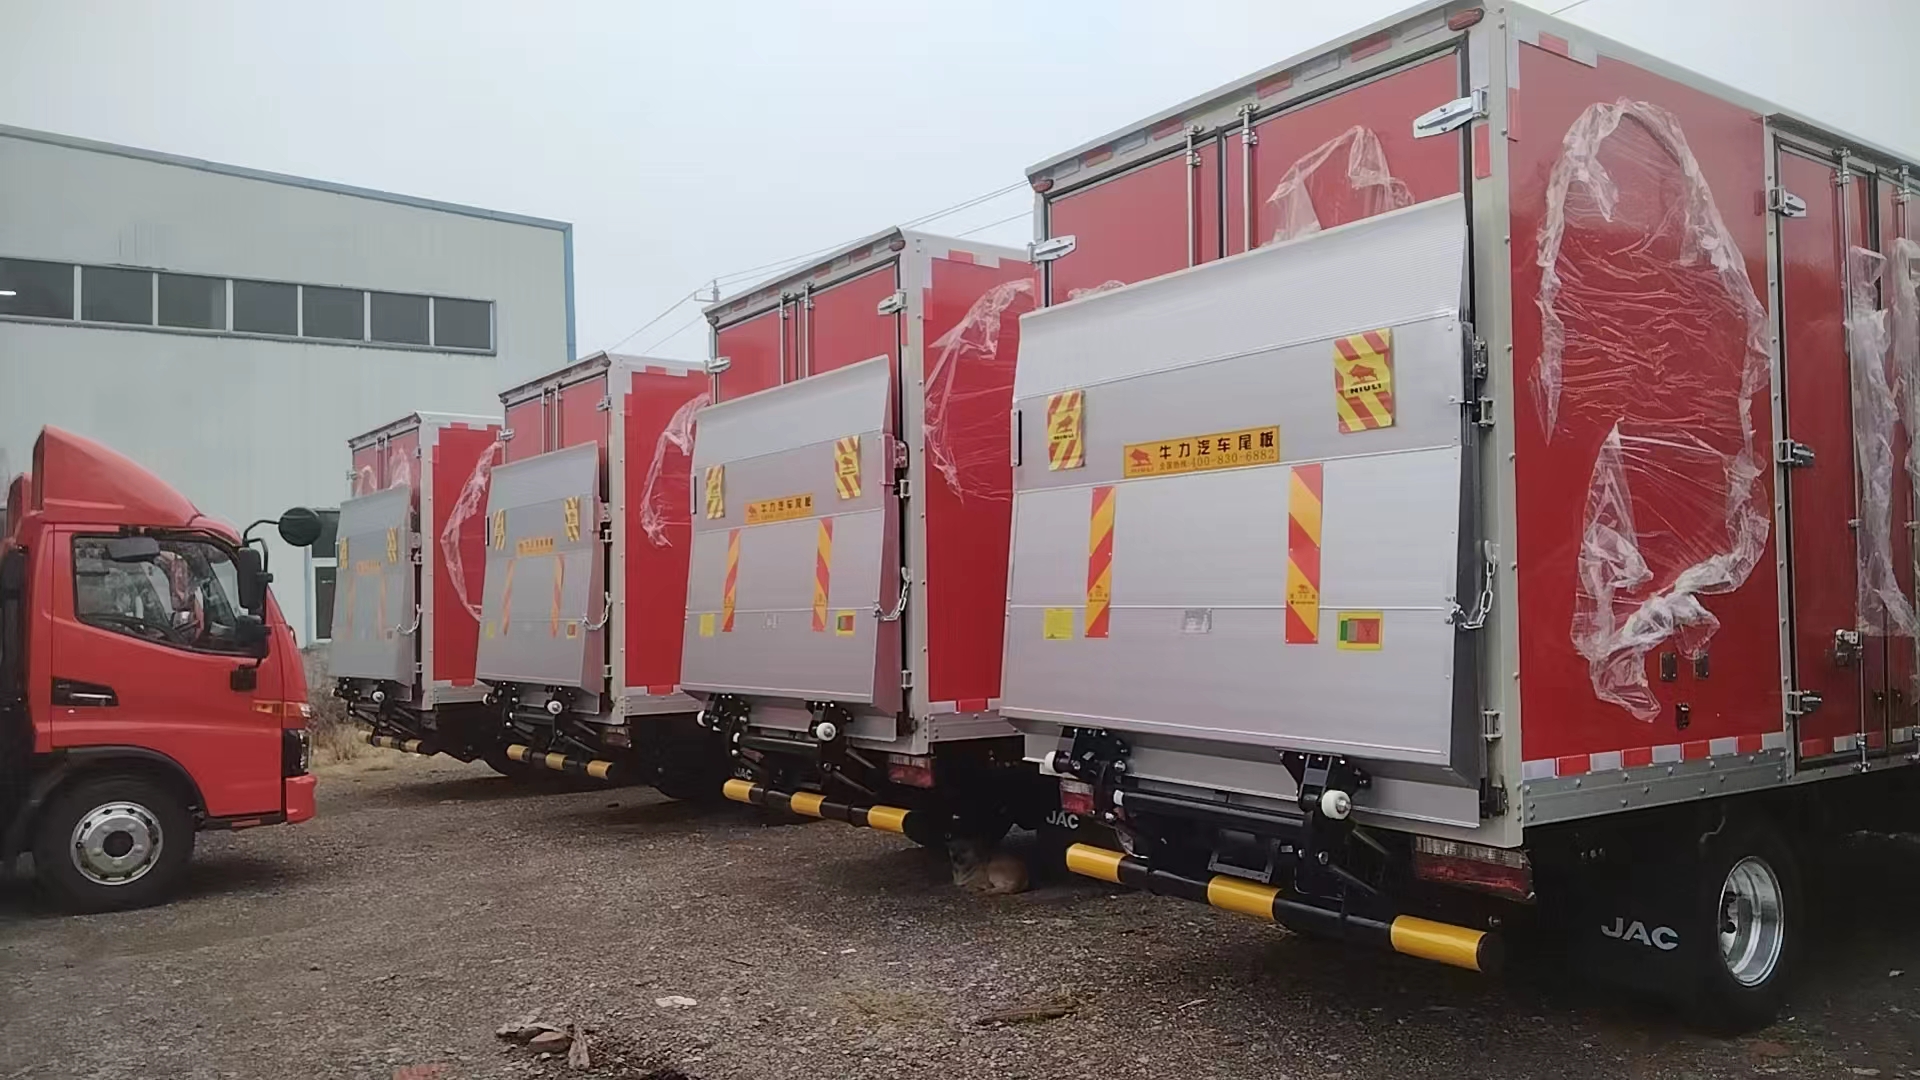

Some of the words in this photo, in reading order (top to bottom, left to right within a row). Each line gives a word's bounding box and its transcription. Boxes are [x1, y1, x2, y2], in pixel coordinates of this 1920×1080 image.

[1350, 383, 1382, 394] NIULI
[1159, 431, 1274, 460] 牛力汽车尾板
[1046, 810, 1079, 829] JAC
[1600, 917, 1679, 950] JAC
